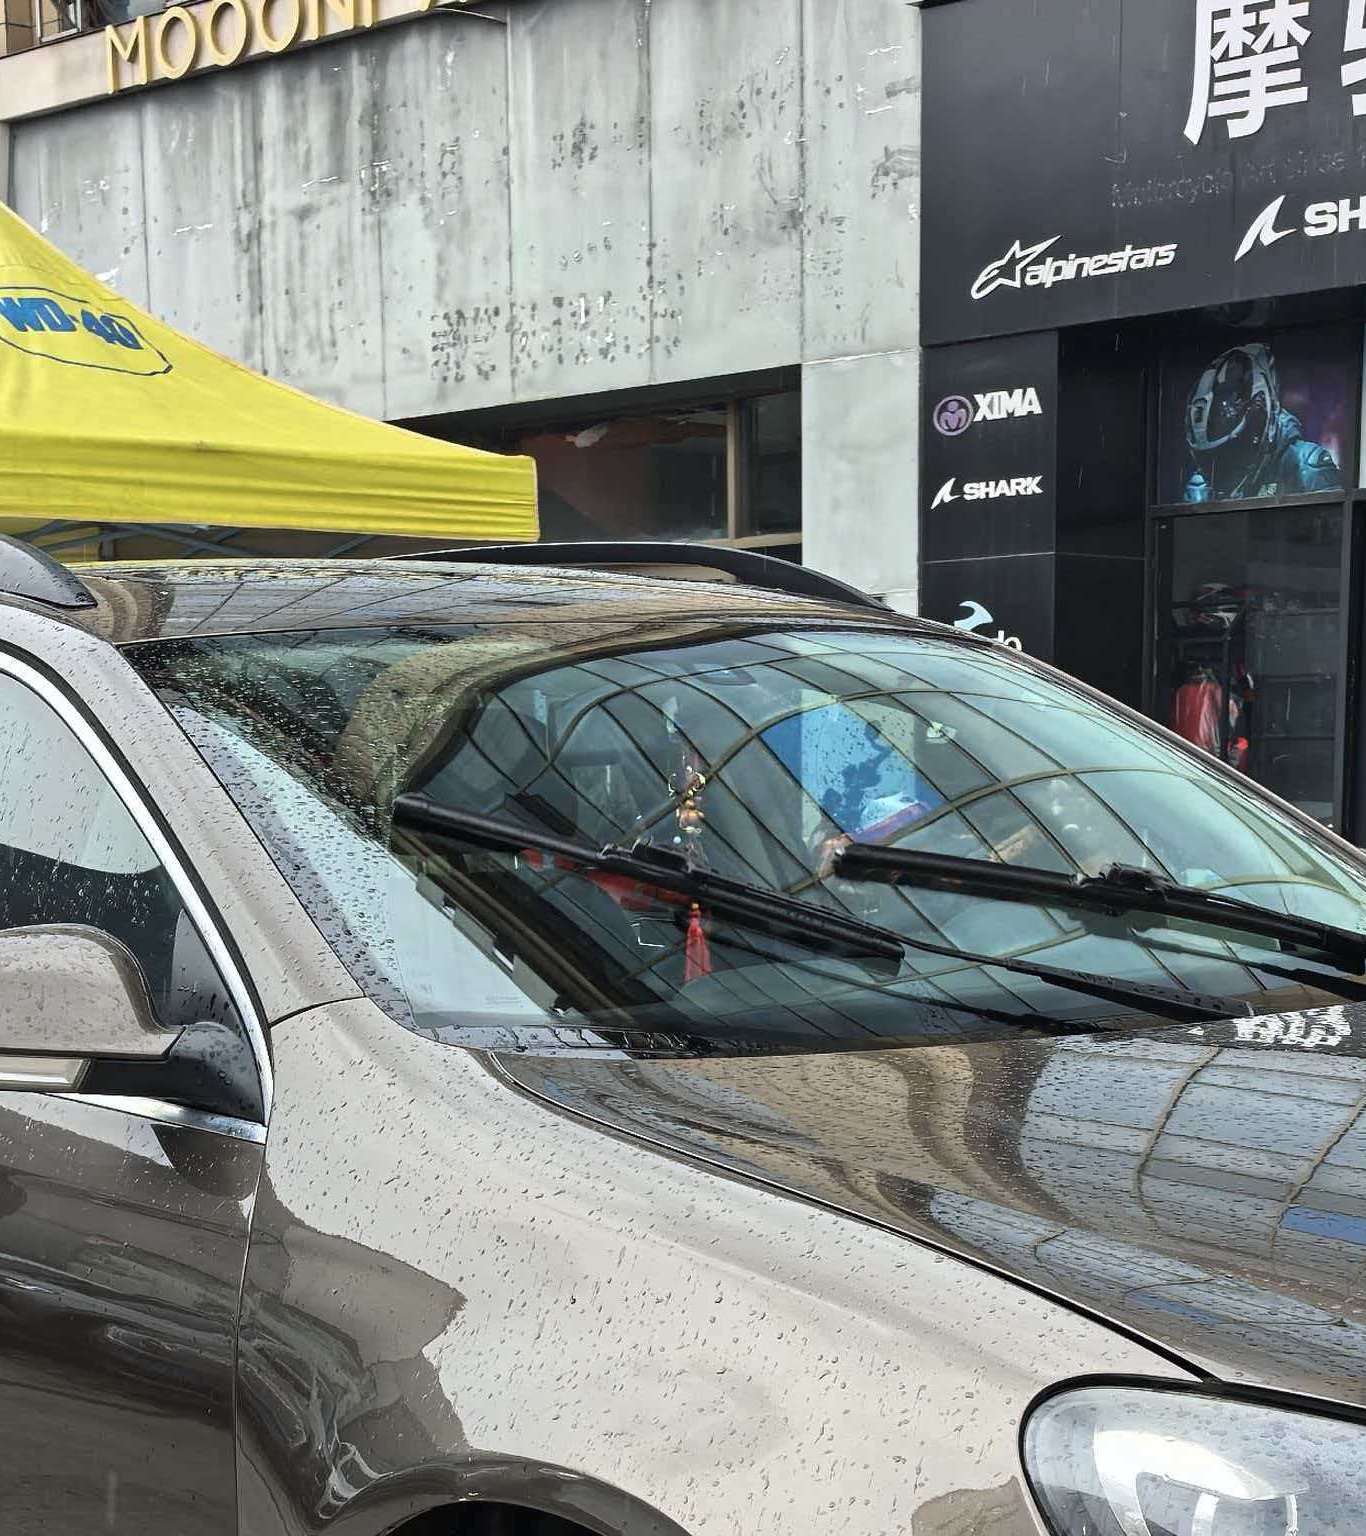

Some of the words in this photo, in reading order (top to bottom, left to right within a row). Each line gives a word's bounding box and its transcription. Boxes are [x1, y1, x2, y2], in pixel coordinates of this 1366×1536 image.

[1024, 241, 1178, 289] alpinestars
[973, 387, 1043, 422] XIMA
[962, 475, 1044, 501] SHARK
